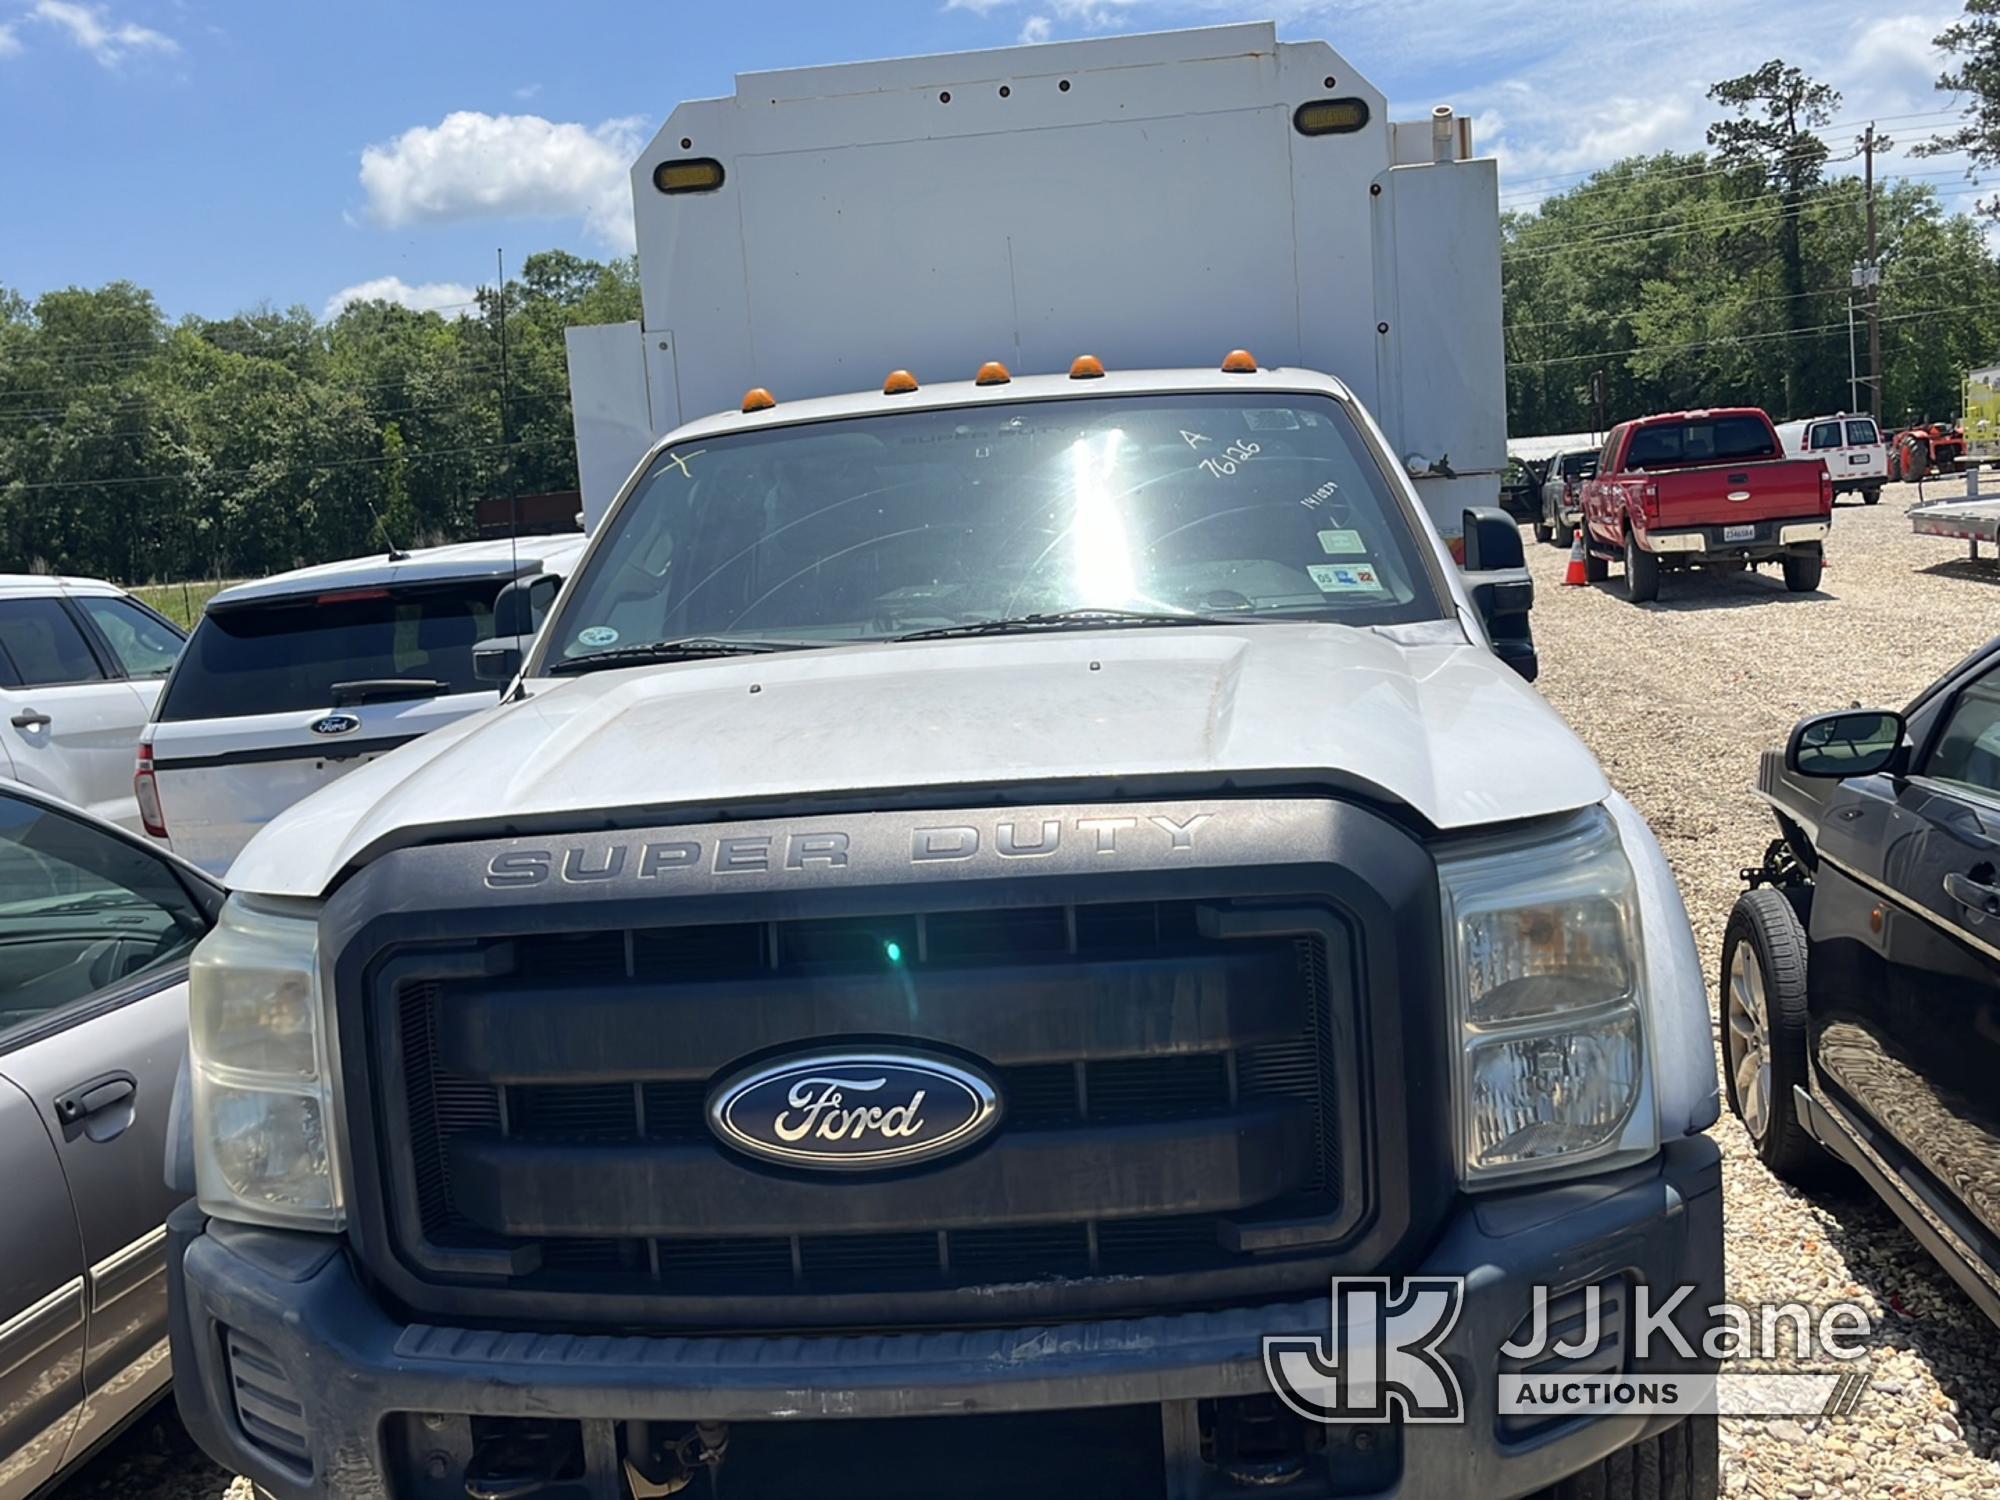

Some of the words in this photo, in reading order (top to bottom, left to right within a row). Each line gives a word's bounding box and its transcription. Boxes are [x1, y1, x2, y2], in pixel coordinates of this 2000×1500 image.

[1179, 430, 1212, 450] A
[1198, 438, 1260, 478] 76126
[318, 718, 348, 732] Ford
[484, 832, 849, 889] SUPER
[910, 813, 1214, 864] DUTY
[774, 1077, 926, 1141] Ford
